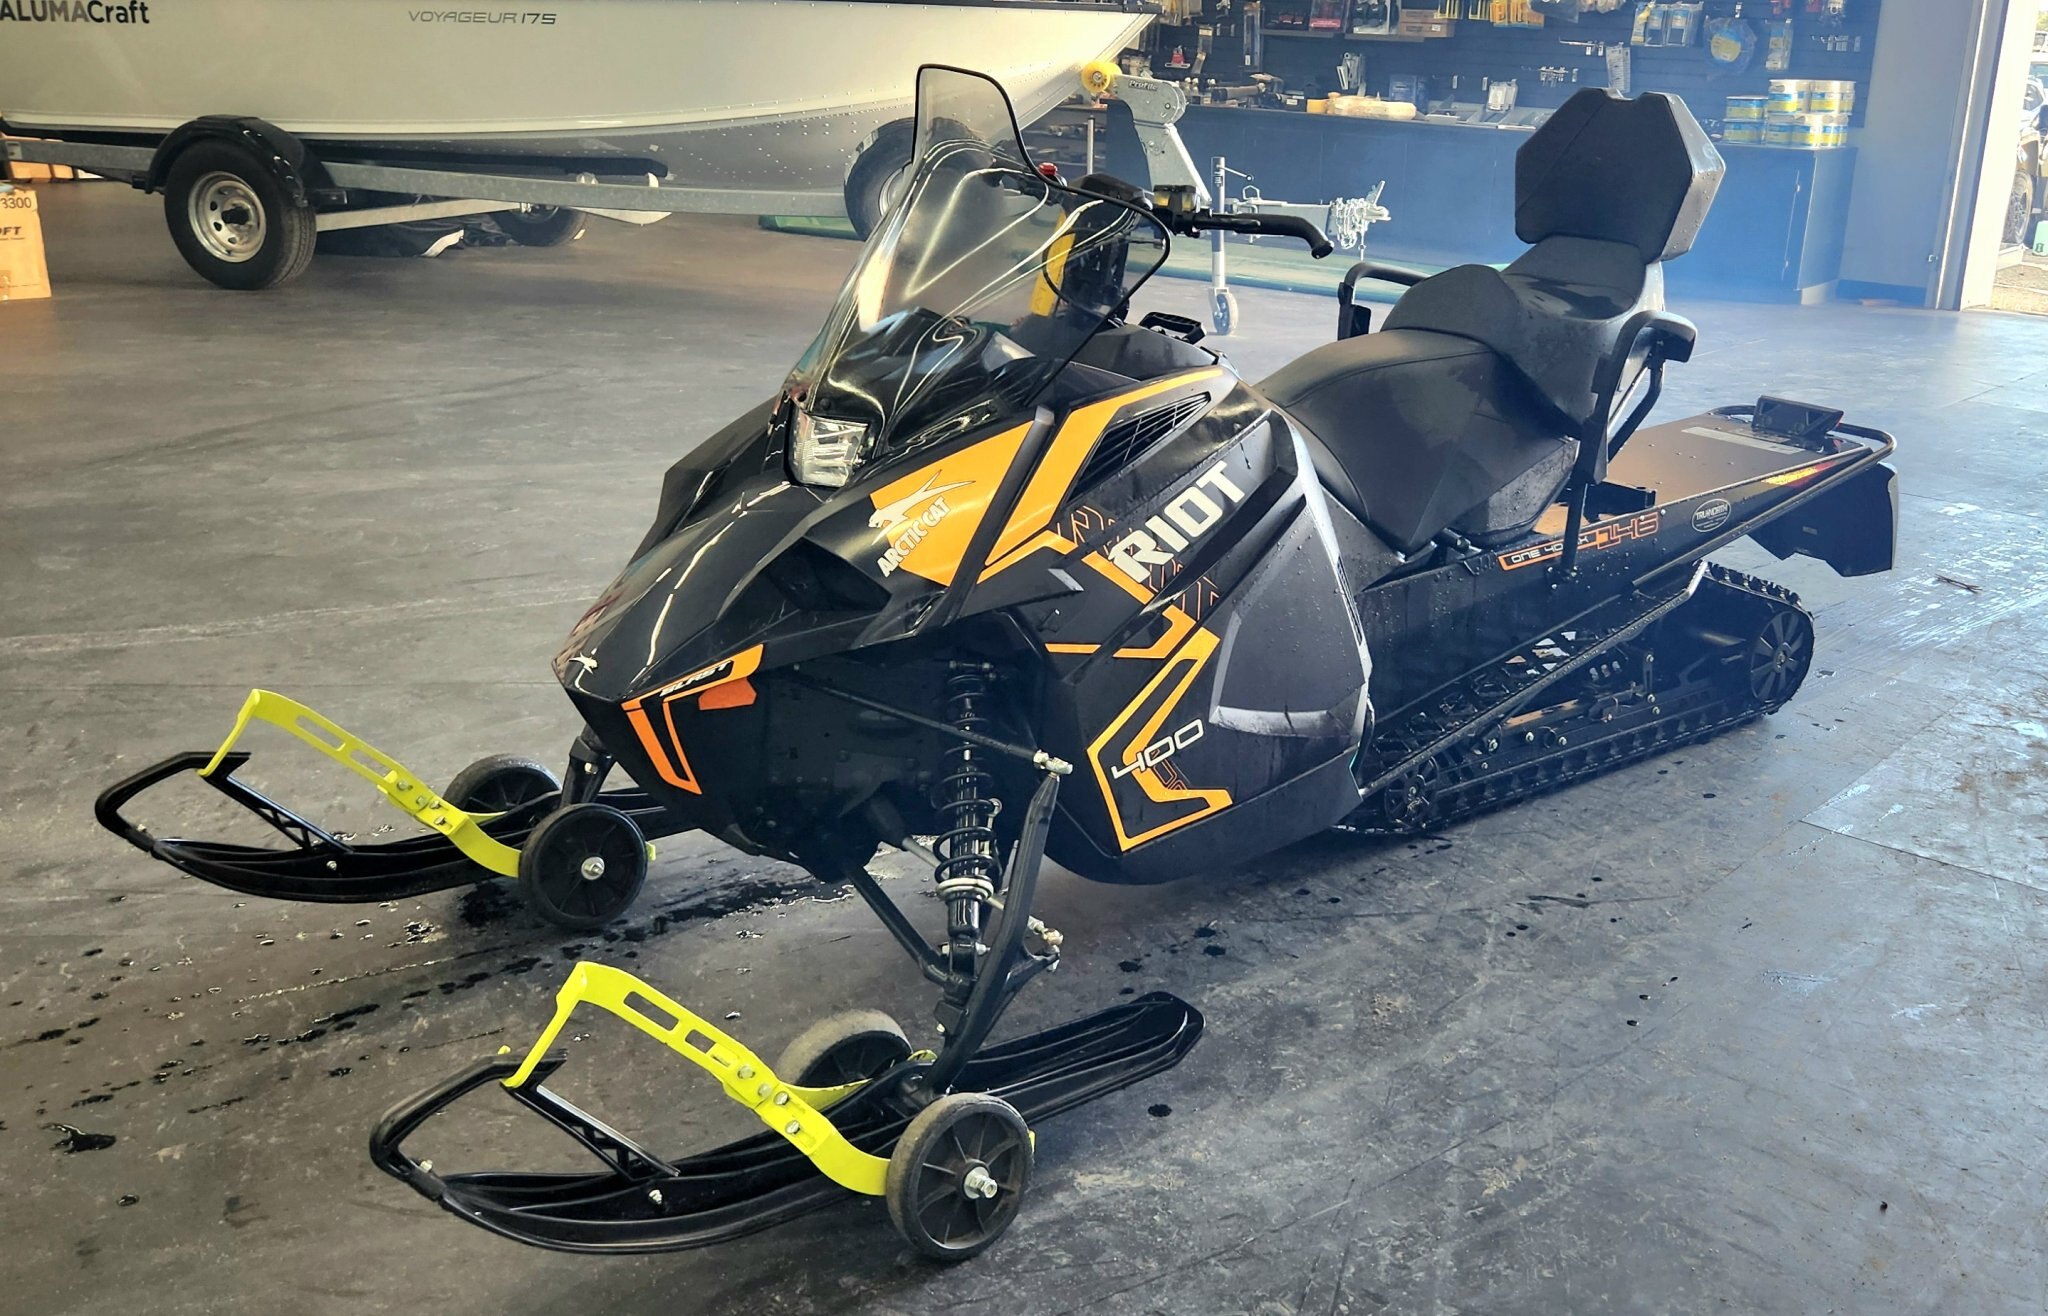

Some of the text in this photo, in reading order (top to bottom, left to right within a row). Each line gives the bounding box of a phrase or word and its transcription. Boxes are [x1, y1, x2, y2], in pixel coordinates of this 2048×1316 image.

[0, 0, 150, 24] ALUMACraft
[408, 11, 558, 25] VOYAGEUR 175
[877, 495, 951, 578] ARCTIC CAT
[1108, 460, 1245, 583] RIOT
[1511, 551, 1541, 564] ONE
[1111, 719, 1204, 779] 400
